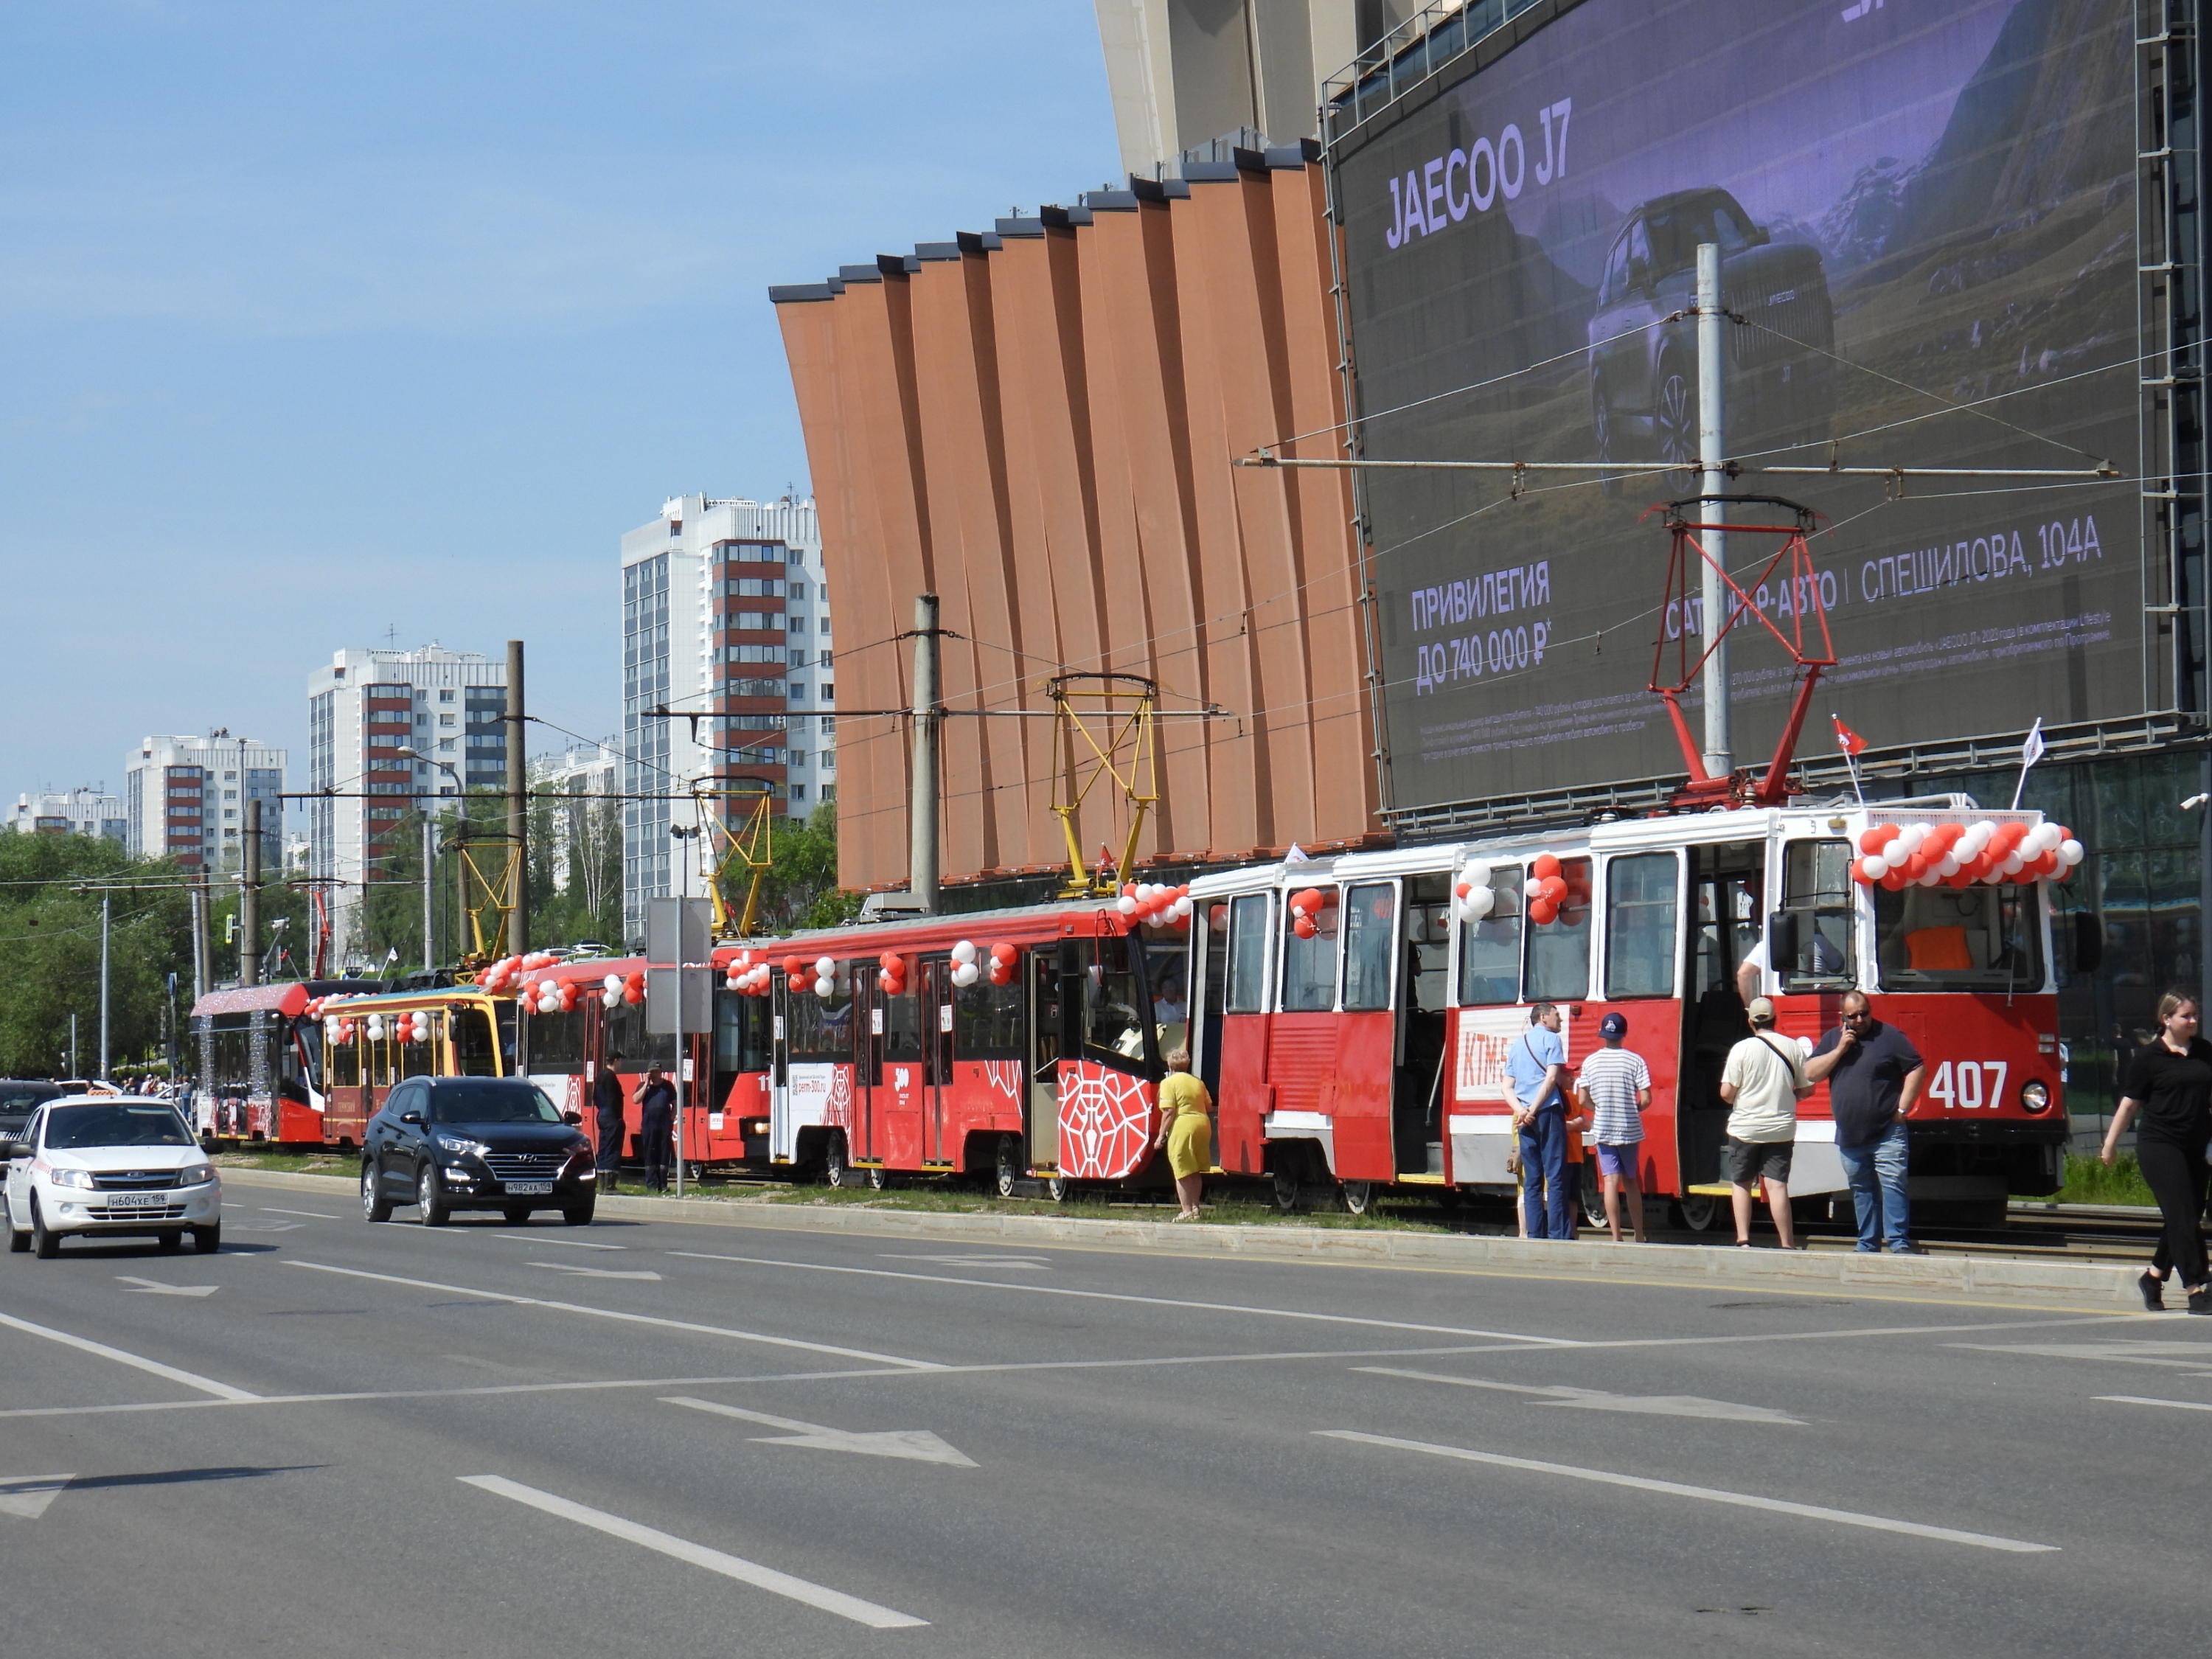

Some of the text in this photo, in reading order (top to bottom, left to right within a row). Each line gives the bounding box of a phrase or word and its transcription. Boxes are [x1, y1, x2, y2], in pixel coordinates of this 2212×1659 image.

[1385, 97, 1573, 250] JAECOO J7
[1412, 560, 1550, 631] ПРИВИЛЕГИЯ
[1861, 530, 2033, 602] СПЕШИЛОВА,
[1416, 642, 1447, 696] ДО
[1450, 634, 1484, 681] 740
[1488, 626, 1528, 674] 000
[799, 1079, 827, 1096] perm-300.ru
[1929, 1060, 2008, 1109] 407
[112, 1195, 149, 1206] Н604ХЕ
[508, 1183, 538, 1192] Н982АА
